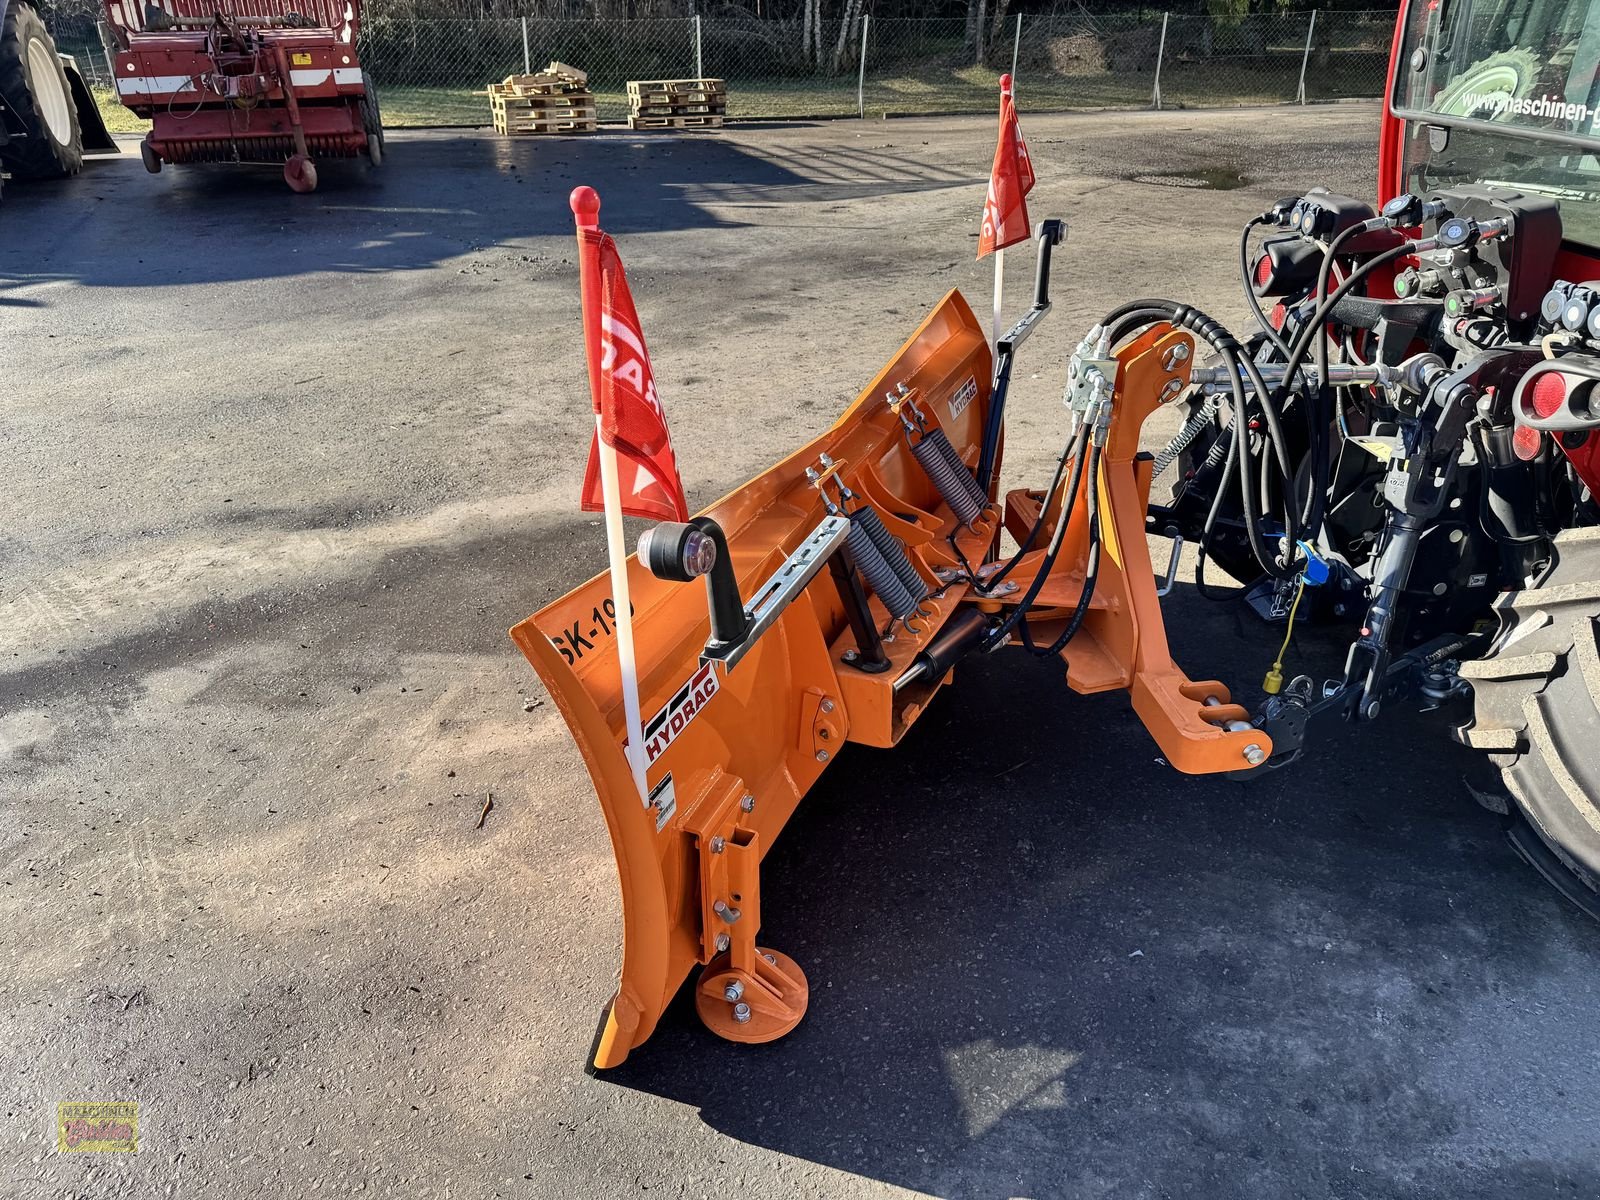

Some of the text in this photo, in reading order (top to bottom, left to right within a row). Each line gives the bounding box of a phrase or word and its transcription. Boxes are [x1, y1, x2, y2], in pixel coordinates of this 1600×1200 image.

[954, 384, 977, 415] HYDRAC
[551, 598, 635, 666] SK-19
[645, 677, 716, 762] HYDRAC
